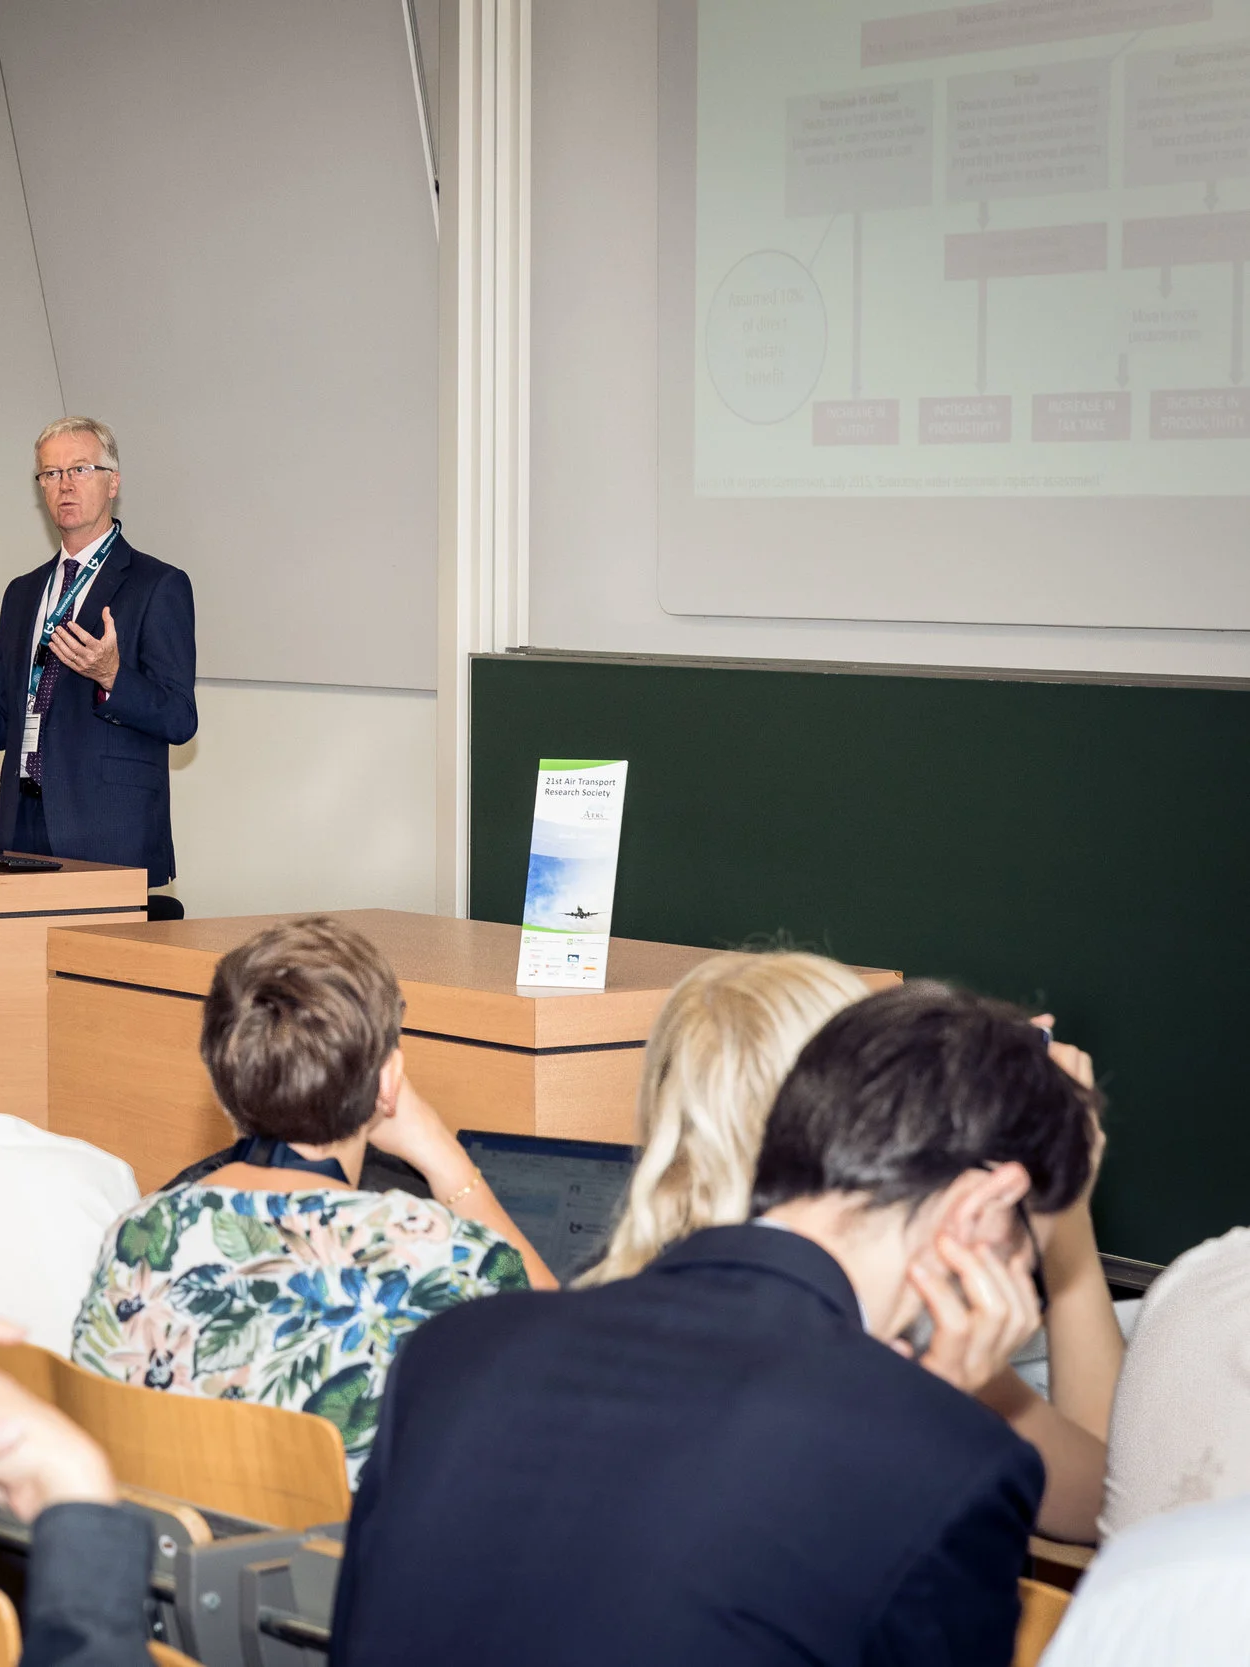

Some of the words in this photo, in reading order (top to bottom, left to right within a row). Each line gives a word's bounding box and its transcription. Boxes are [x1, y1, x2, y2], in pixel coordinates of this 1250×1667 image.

[728, 289, 777, 308] Assumed
[756, 315, 788, 332] direct
[744, 368, 785, 387] benefit
[933, 403, 984, 418] INCREASE
[1048, 399, 1103, 413] INCREASE
[1104, 398, 1117, 411] IN
[1166, 395, 1225, 411] INCREASE
[1227, 395, 1241, 408] IN
[835, 423, 877, 437] OUTPUT
[927, 420, 1002, 436] PRODUCTIVITY
[1057, 418, 1076, 432] TAX
[1078, 418, 1109, 432] TAKE
[1160, 415, 1246, 430] PRODUCTIVITY
[55, 592, 73, 617] Universiteit
[71, 573, 88, 595] Antwerpen
[545, 777, 562, 785] 21st
[563, 777, 577, 786] Air
[578, 778, 616, 788] Transport
[545, 788, 580, 797] Research
[582, 789, 611, 798] Society
